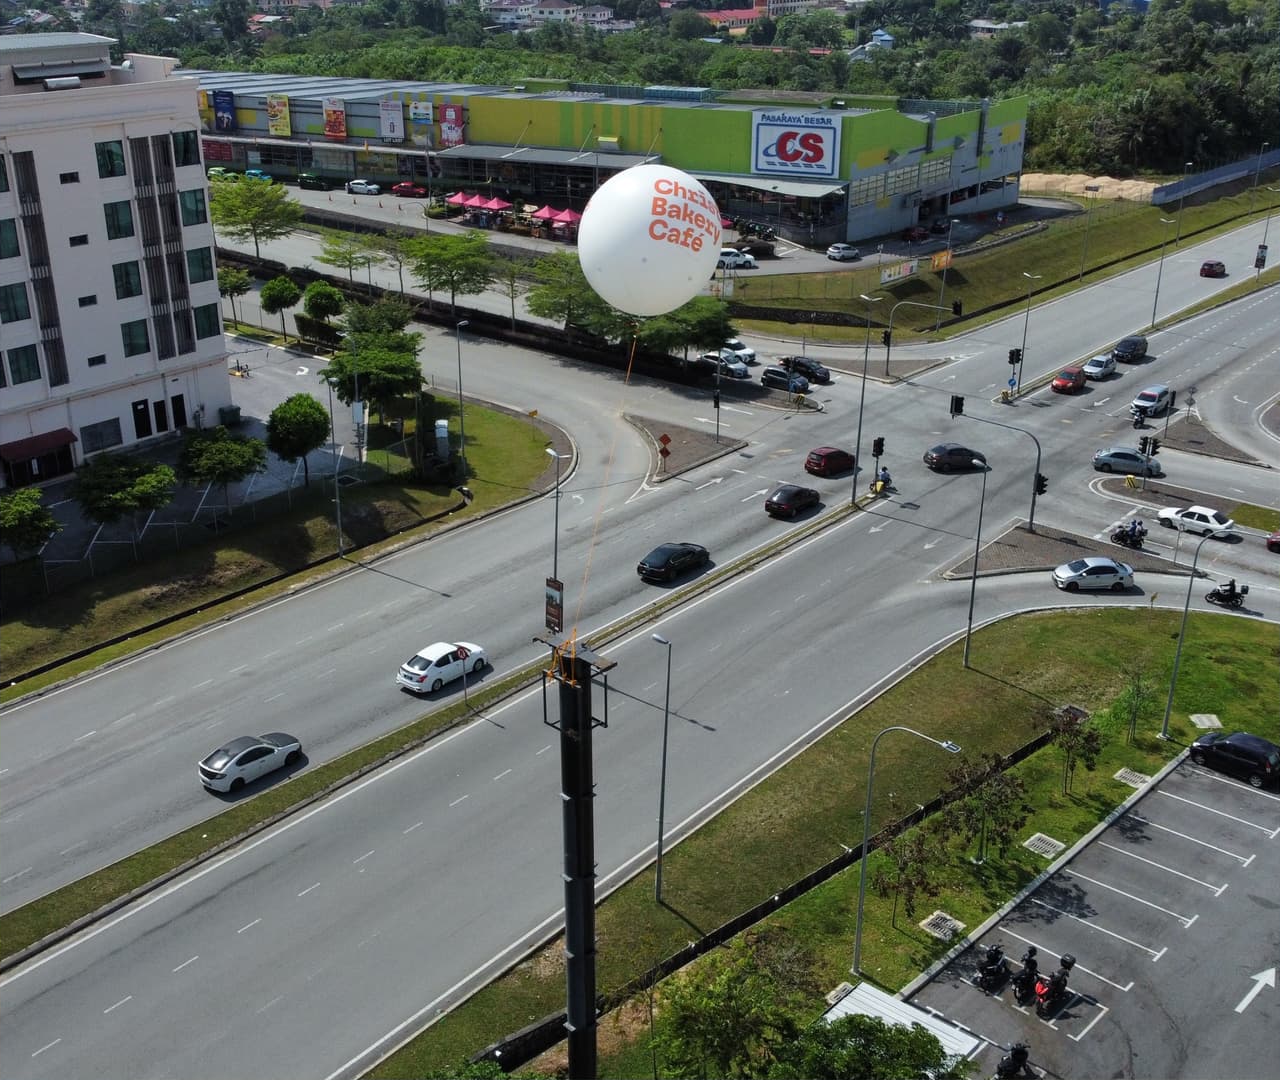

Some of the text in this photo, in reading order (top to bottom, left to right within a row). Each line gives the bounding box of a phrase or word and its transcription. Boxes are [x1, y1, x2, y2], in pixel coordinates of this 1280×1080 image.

[761, 113, 832, 125] PASARAYA BESAR
[776, 131, 824, 163] CS
[648, 219, 704, 252] Café
[651, 197, 720, 245] Bakery
